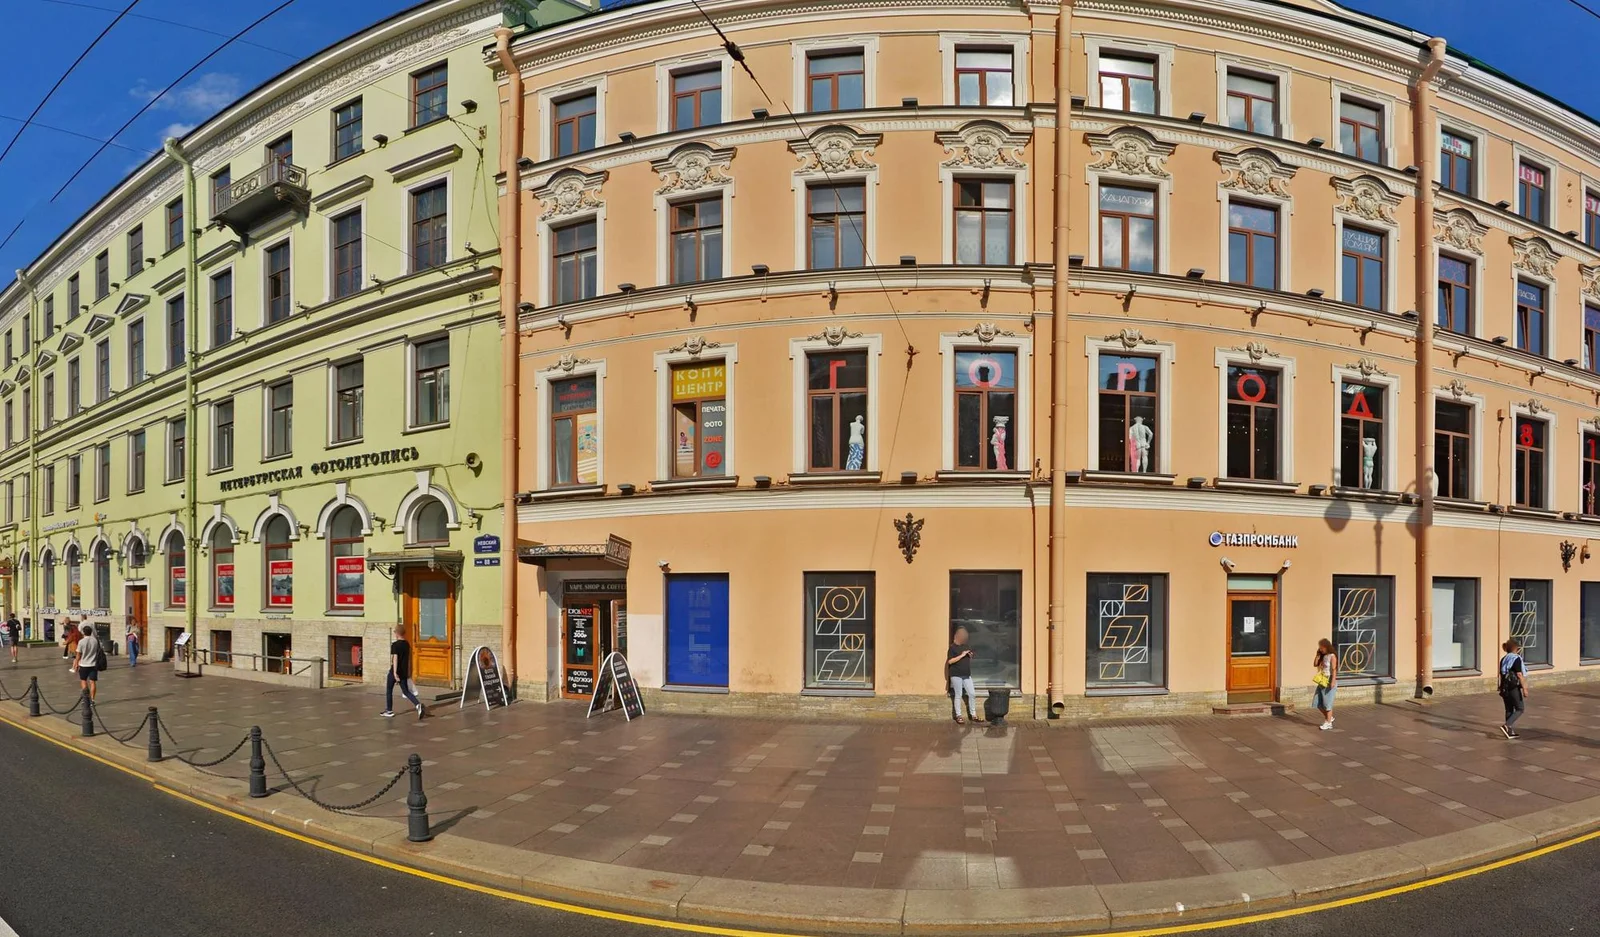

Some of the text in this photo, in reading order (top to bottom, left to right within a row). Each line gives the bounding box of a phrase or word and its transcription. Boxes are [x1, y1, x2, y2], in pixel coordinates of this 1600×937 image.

[676, 367, 723, 381] КОПИ
[676, 381, 723, 395] ЦЕНТР
[829, 360, 846, 389] Г
[968, 358, 1001, 388] О
[1117, 363, 1137, 391] Р
[1237, 374, 1266, 402] О
[1520, 423, 1534, 447] 8
[704, 420, 723, 428] ФОТО
[704, 435, 723, 443] ZONE
[220, 446, 420, 492] ПЕТЕРБУРГСКАЯ ФОТОЛЕТОПИСЬ
[1225, 533, 1299, 548] ГАЗПРОМБАНК
